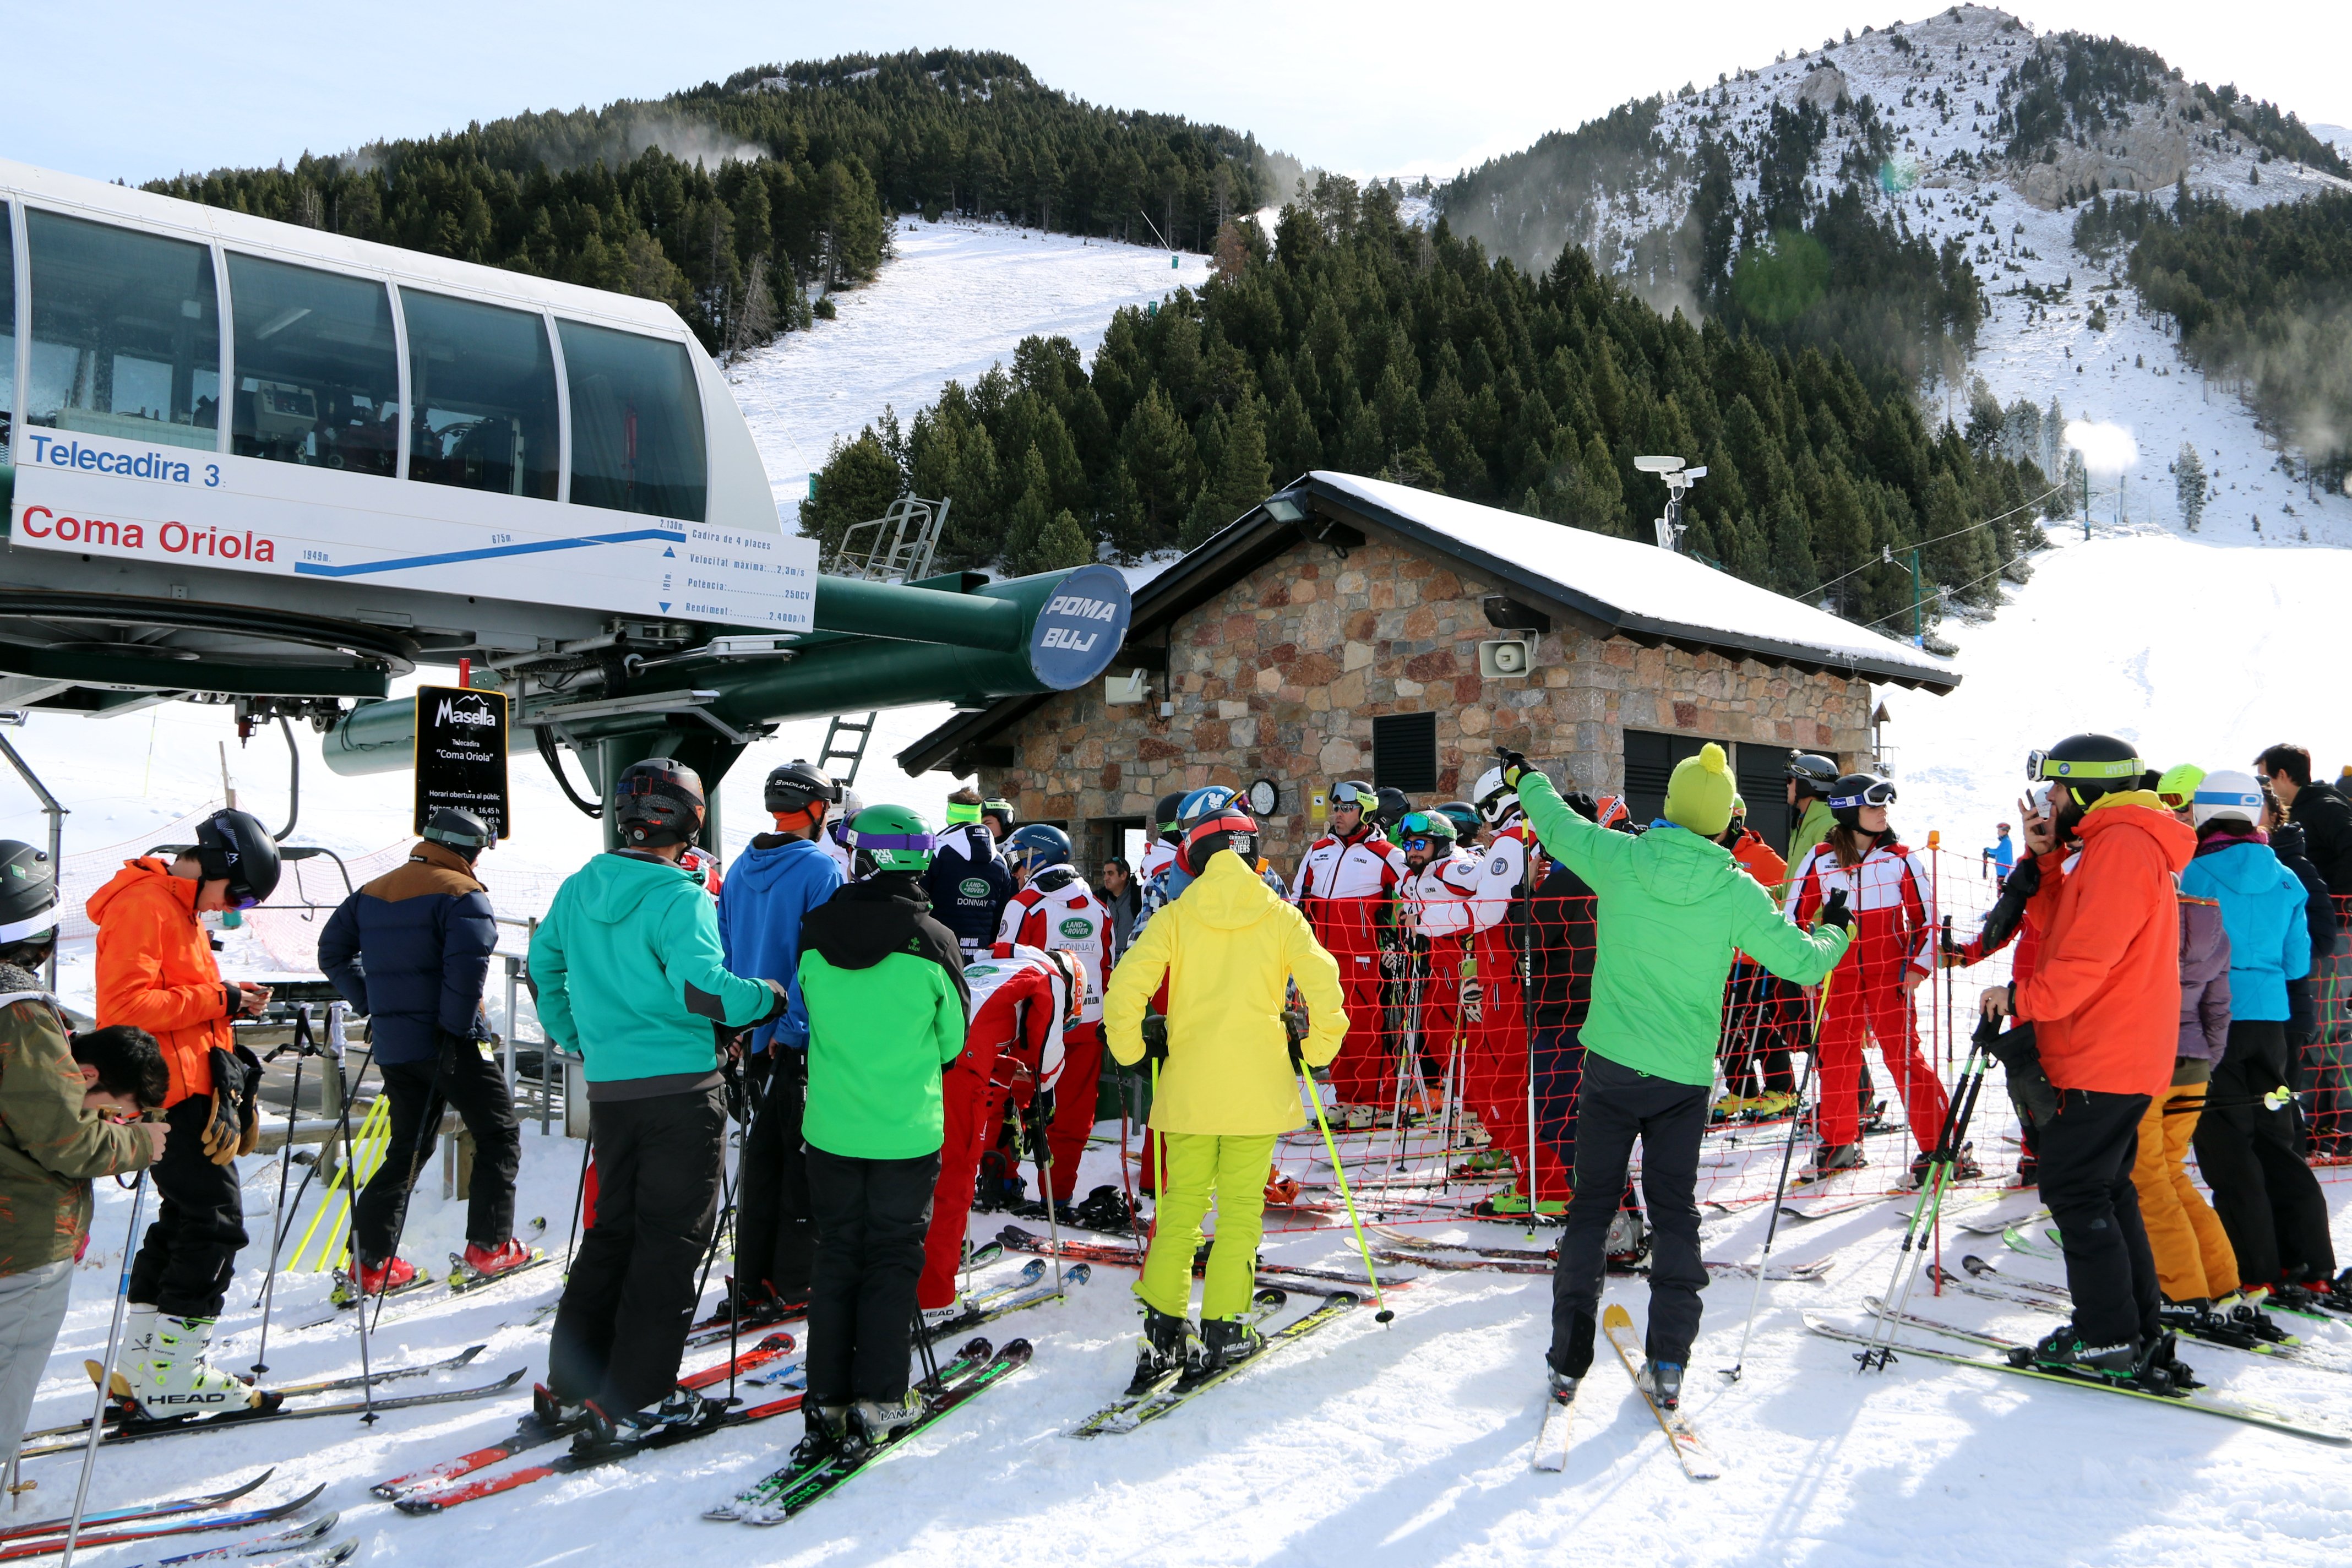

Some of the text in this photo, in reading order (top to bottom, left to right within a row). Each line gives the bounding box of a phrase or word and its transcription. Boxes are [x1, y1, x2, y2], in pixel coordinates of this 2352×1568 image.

[29, 434, 220, 487] Telecadira 3
[660, 519, 685, 531] 2.130m.
[23, 505, 274, 562] Coma Oriola
[492, 533, 514, 544] 675m.
[693, 529, 771, 550] Cadira de 4 places
[303, 550, 332, 562] 1949m.
[690, 554, 728, 567] Velocitat
[662, 571, 672, 591] 181m.
[1046, 596, 1117, 622] POMA
[1040, 628, 1098, 652] BUJ
[435, 697, 496, 727] Masella
[452, 739, 480, 747] Telecadira
[1229, 844, 1250, 853] SKIERS
[957, 897, 988, 907] DONNAY
[1059, 942, 1095, 951] DONNAY
[922, 1309, 954, 1318] HEAD
[2160, 1305, 2197, 1314] EAD
[1222, 1341, 1250, 1354] HEAD
[148, 1393, 226, 1405] HEAD
[880, 1407, 918, 1423] LANGE
